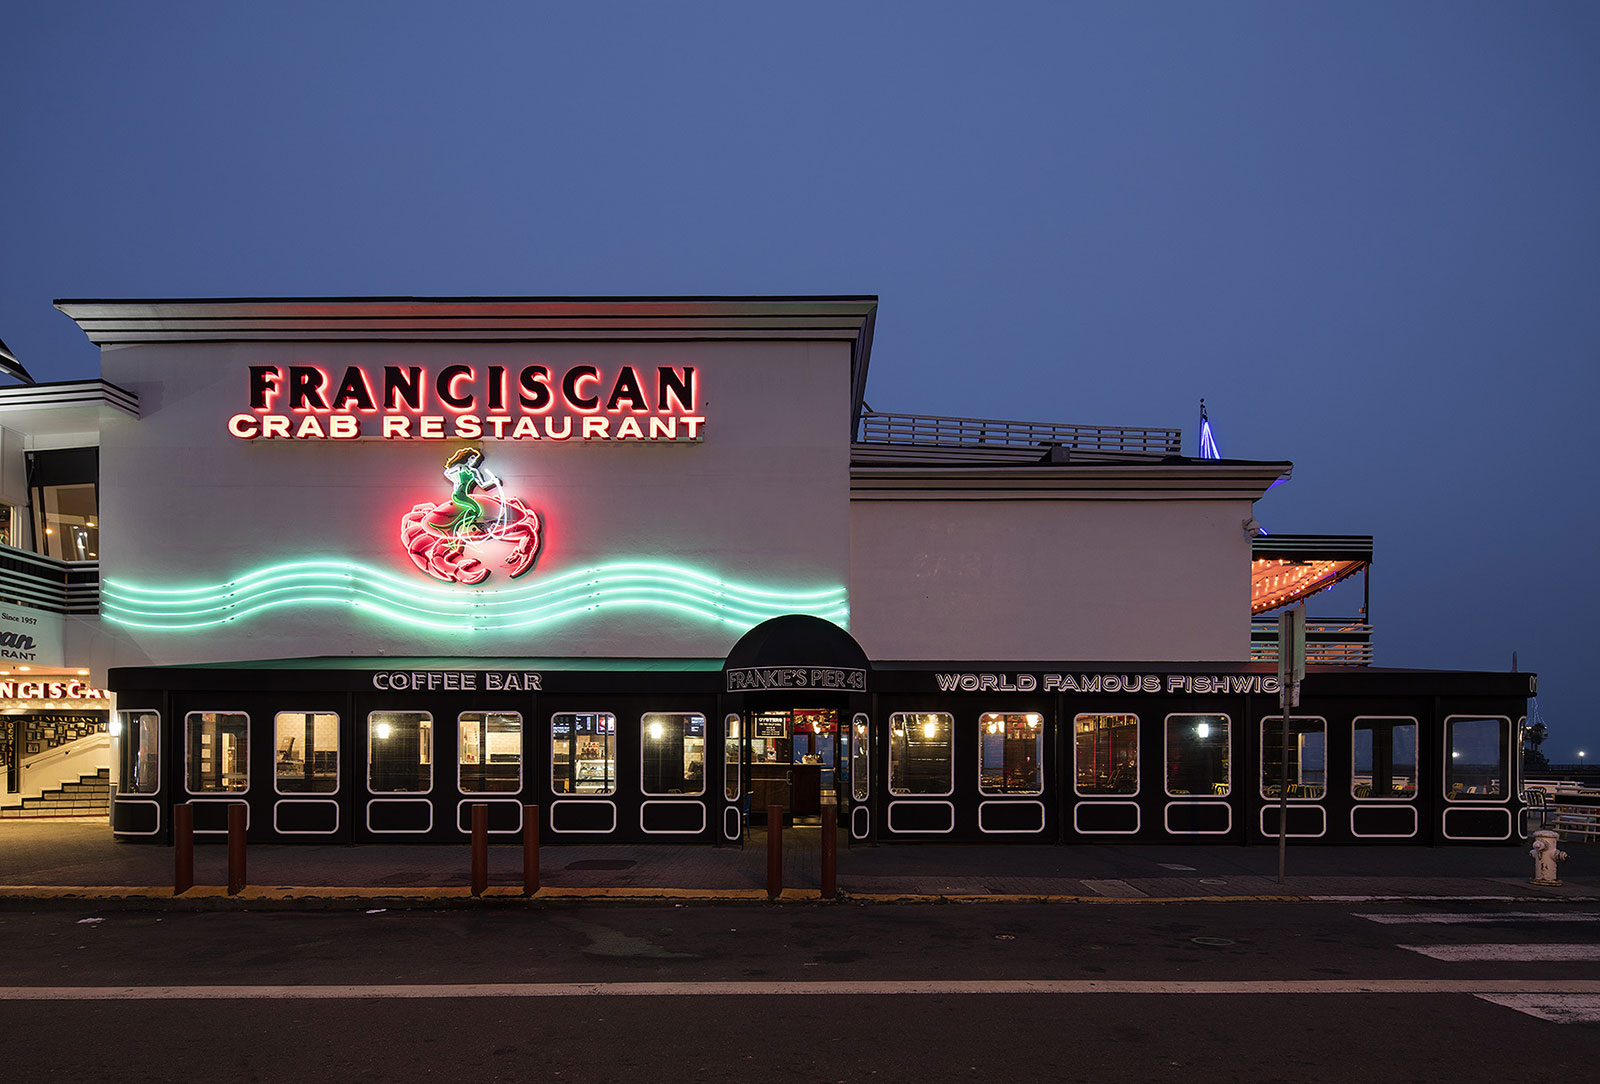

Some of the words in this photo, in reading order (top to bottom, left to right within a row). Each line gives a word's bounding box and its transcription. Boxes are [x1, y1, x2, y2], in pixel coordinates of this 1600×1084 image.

[248, 365, 697, 413] FRANCISCAN
[227, 414, 361, 439] CRAB
[383, 414, 705, 440] RESTAURANT
[2, 612, 20, 622] Since
[21, 616, 37, 625] 1957
[0, 631, 37, 650] an
[1, 644, 37, 661] RANT
[372, 671, 477, 691] COFFEE
[485, 672, 543, 691] BAR
[729, 668, 808, 689] FRANKIE'S
[811, 669, 846, 687] PIER
[846, 671, 864, 688] 43
[935, 673, 1037, 692] WORLD
[1043, 674, 1161, 693] FAMOUS
[1167, 675, 1281, 694] FISHWIC
